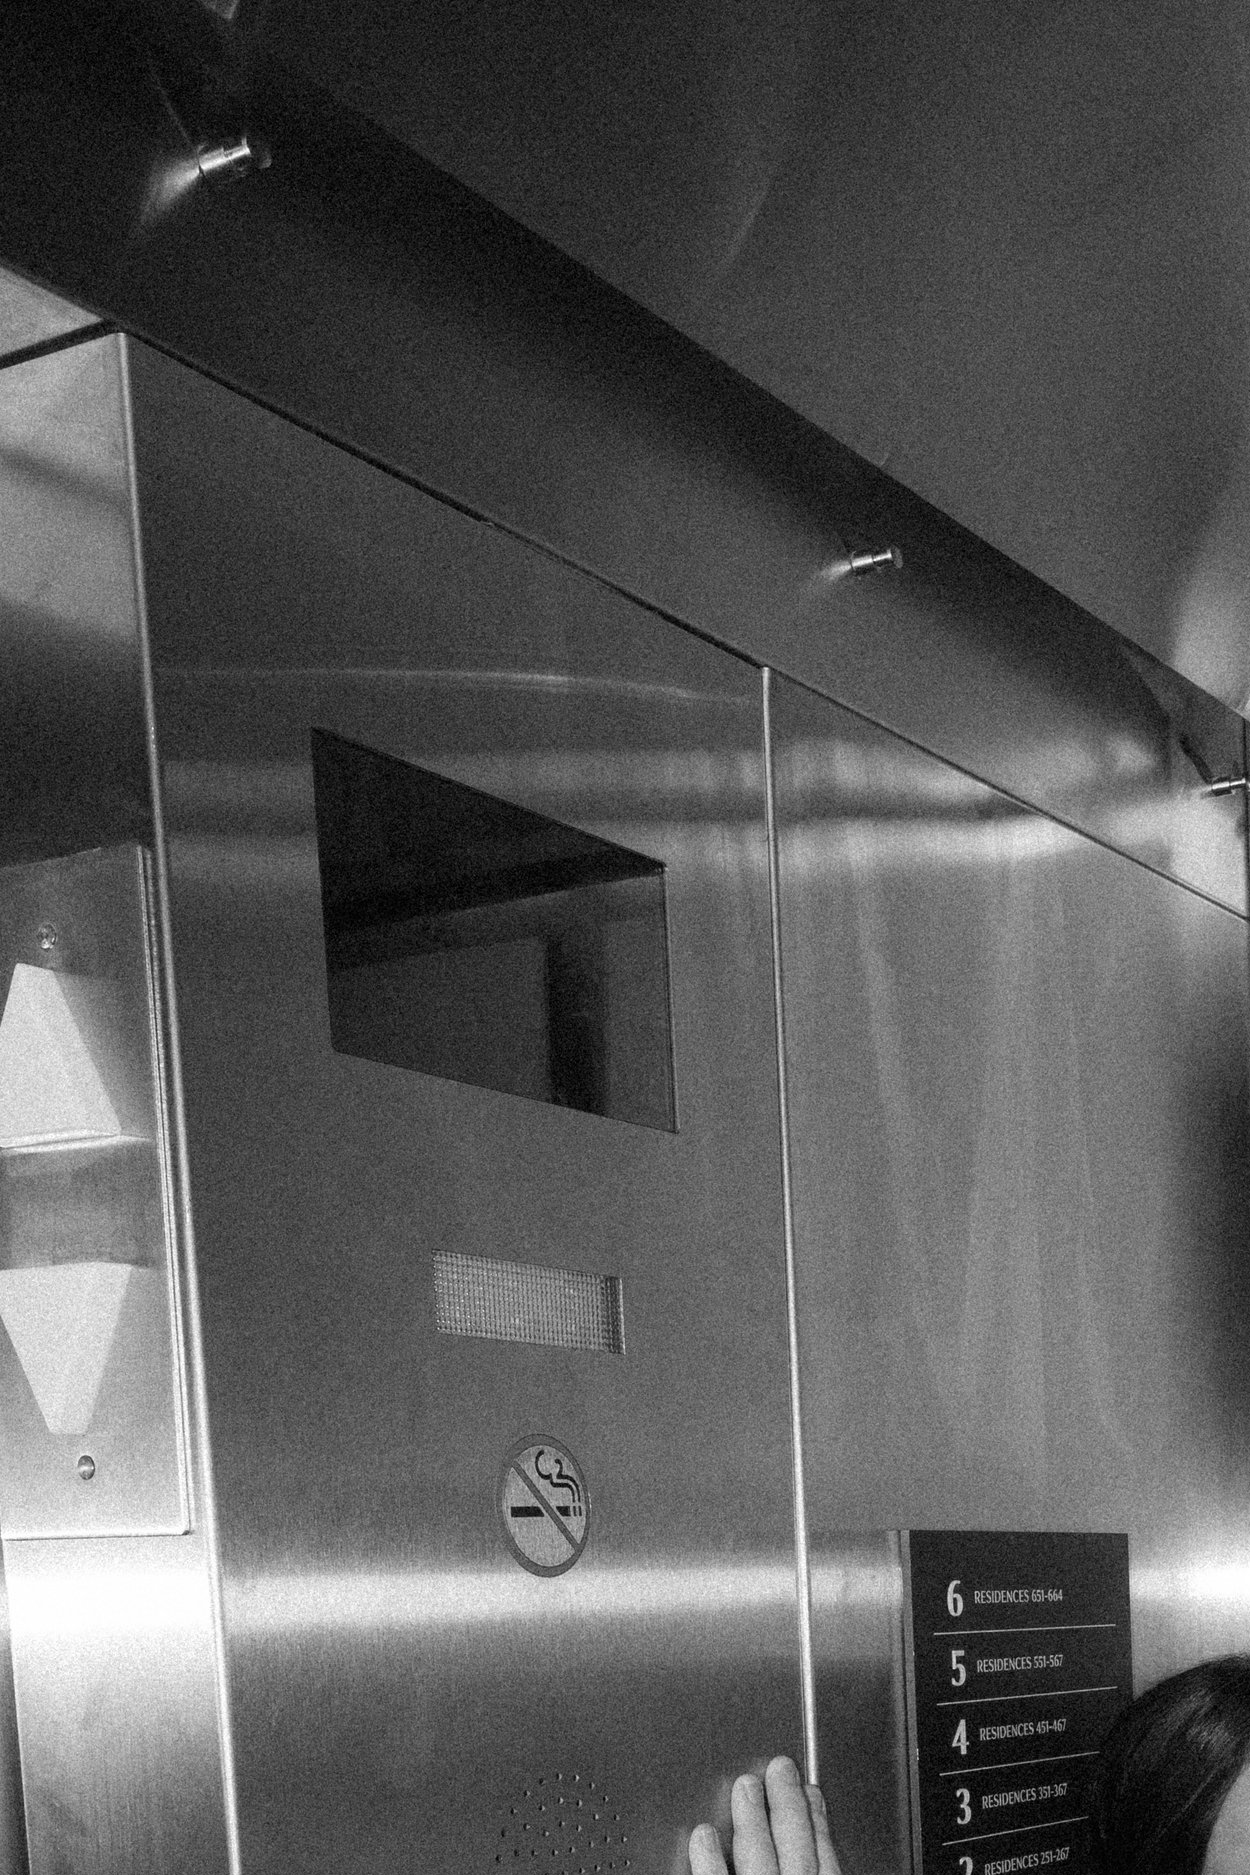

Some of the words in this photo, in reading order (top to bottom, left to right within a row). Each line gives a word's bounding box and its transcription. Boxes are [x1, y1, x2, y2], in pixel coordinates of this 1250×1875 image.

[947, 1580, 963, 1617] 6
[974, 1590, 1030, 1604] RESIDENCES
[1031, 1588, 1063, 1603] 651-664
[951, 1649, 967, 1687] 5
[976, 1656, 1032, 1673] RESIDENCES
[1033, 1654, 1064, 1669] 551-567
[952, 1719, 970, 1755] 4
[979, 1722, 1035, 1741] RESIDENCES
[1036, 1718, 1067, 1734] 451-467
[956, 1788, 972, 1825] 3
[982, 1788, 1037, 1810] RESIDENCES
[1038, 1782, 1068, 1800] 351-367
[1041, 1847, 1070, 1865] 251-267
